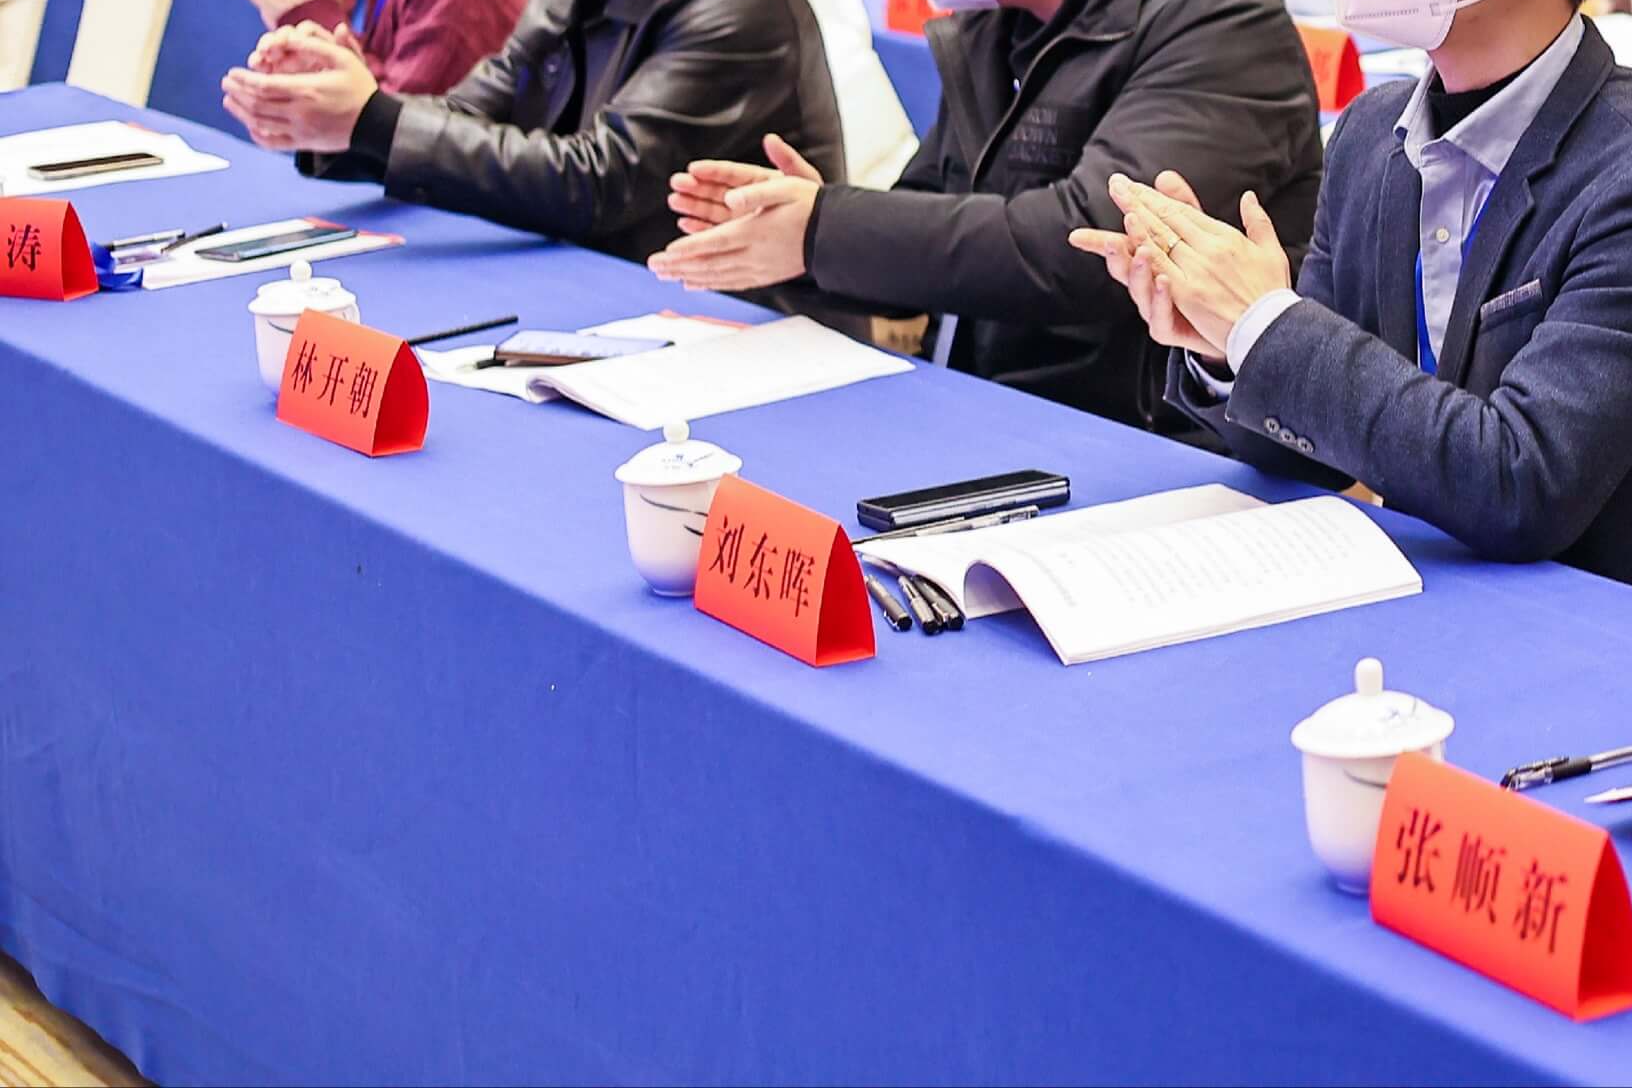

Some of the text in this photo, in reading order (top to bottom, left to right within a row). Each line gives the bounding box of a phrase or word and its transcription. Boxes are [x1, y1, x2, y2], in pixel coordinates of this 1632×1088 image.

[7, 223, 42, 272] 涛
[291, 339, 379, 418] 林开朝
[708, 514, 815, 618] 刘东晖
[1395, 808, 1568, 955] 张顺新
